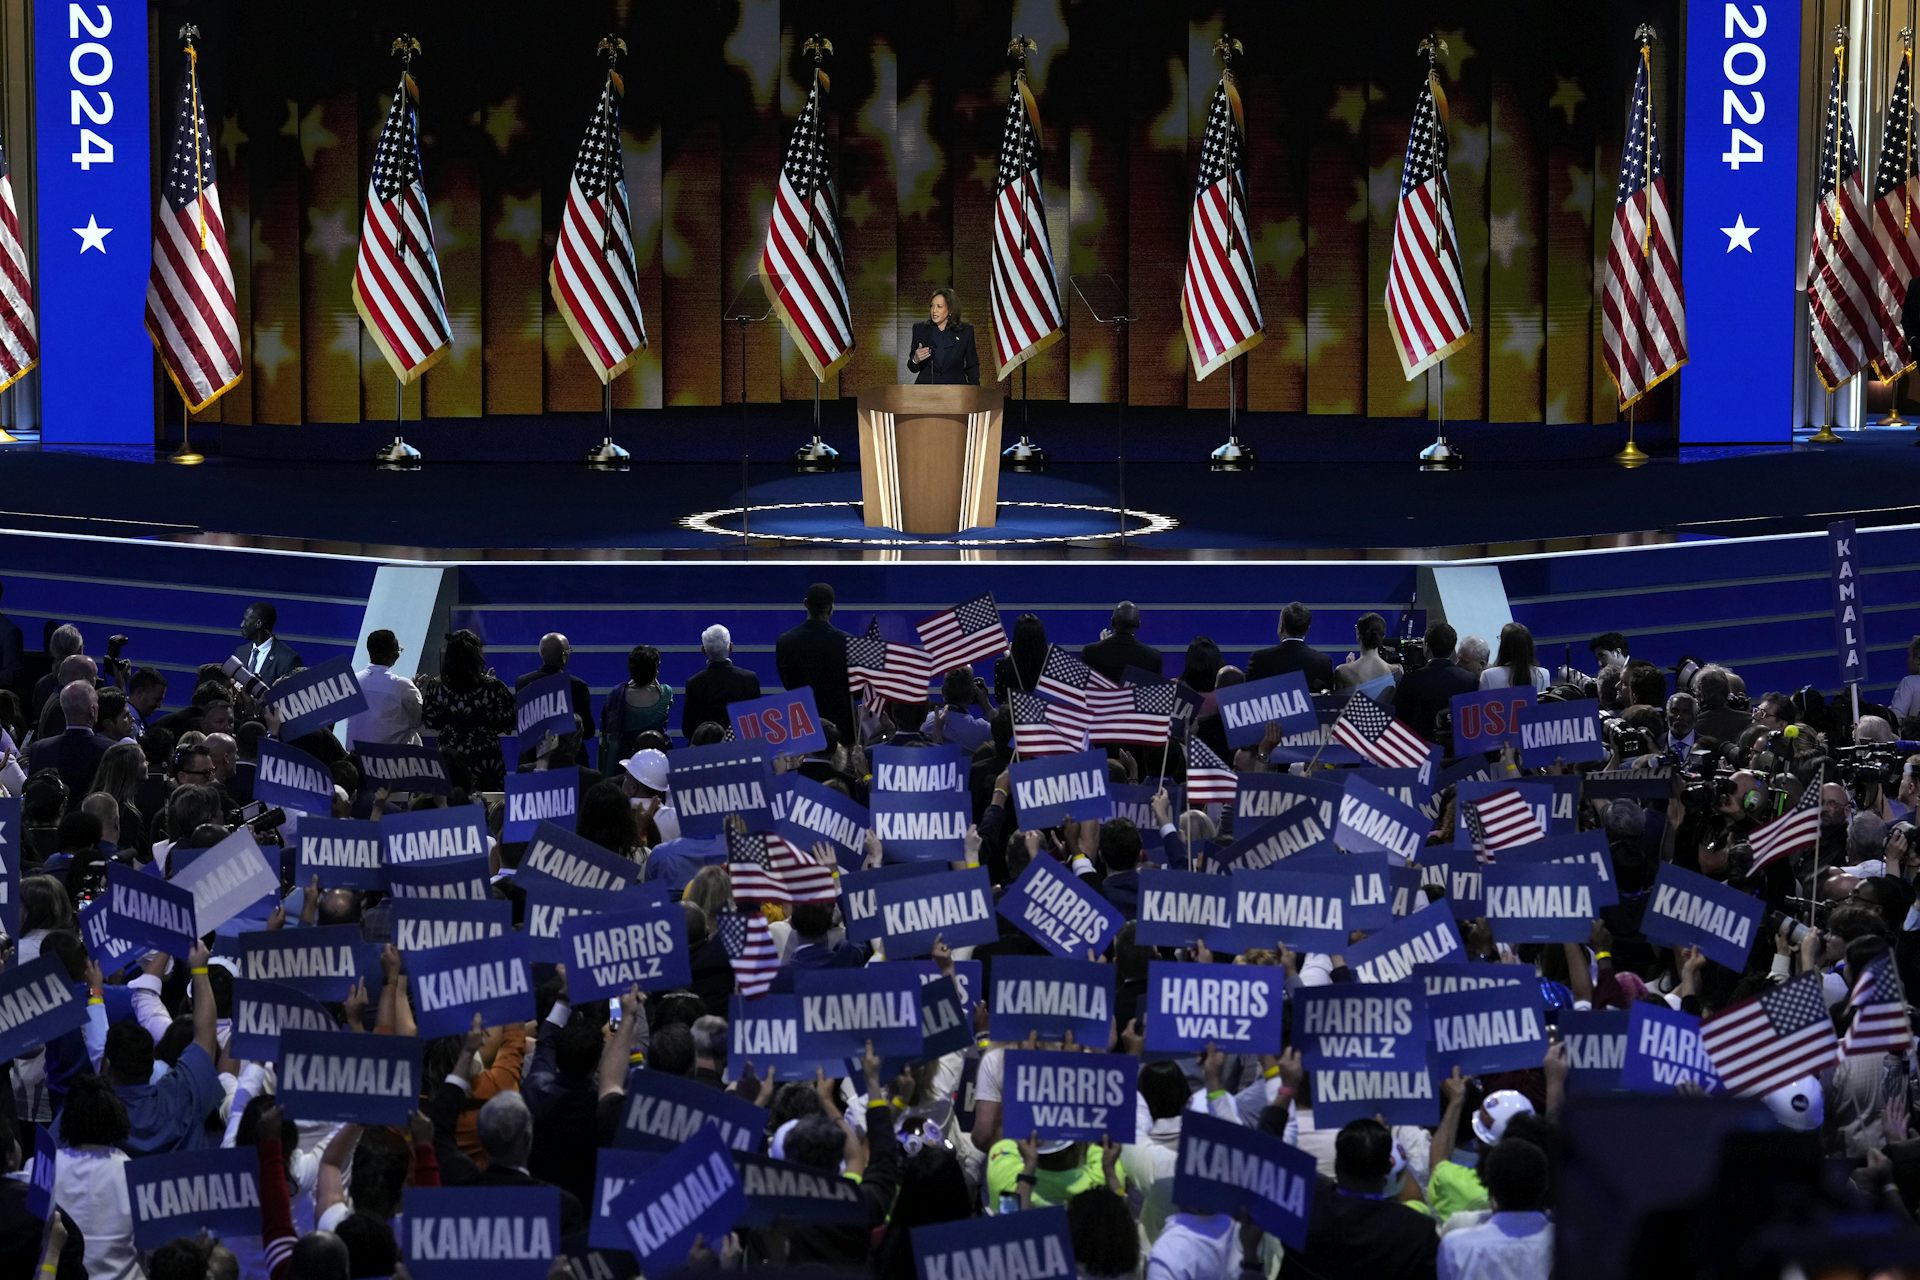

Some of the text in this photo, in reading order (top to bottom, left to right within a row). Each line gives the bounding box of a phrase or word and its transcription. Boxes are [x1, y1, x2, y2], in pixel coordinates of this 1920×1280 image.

[69, 3, 114, 171] 2024
[1722, 3, 1767, 170] 2024
[1836, 538, 1859, 667] KAMALA
[273, 672, 357, 723] KAMALA
[518, 689, 569, 734] KAMALA
[1223, 689, 1310, 729] KAMALA
[738, 702, 816, 745] USA
[1521, 716, 1597, 750] KAMALA
[360, 755, 446, 780] KAMALA
[878, 762, 957, 792] KAMALA
[509, 787, 575, 822] KAMALA
[677, 781, 767, 817] KAMALA
[1016, 769, 1106, 810] KAMALA
[389, 825, 482, 864] KAMALA
[790, 796, 866, 855] KAMALA
[876, 812, 967, 840] KAMALA
[1338, 793, 1420, 862] KAMALA
[302, 836, 387, 869] KAMAL
[112, 884, 195, 938] KAMALA
[883, 889, 991, 936] KAMALA
[1024, 867, 1109, 945] HARRIS
[1142, 890, 1231, 929] KAMAL
[1236, 891, 1343, 930] KAMALA
[1486, 886, 1594, 918] KAMALA
[1653, 883, 1750, 949] KAMALA
[573, 920, 674, 969] HARRIS
[1023, 902, 1082, 953] WALZ
[247, 945, 356, 980] KAMALA
[592, 957, 663, 988] WALZ
[418, 958, 529, 1013] KAMALA
[996, 980, 1107, 1022] KAMALA
[1161, 977, 1269, 1018] HARRIS
[803, 991, 918, 1033] KAMALA
[1176, 1017, 1252, 1041] WALZ
[1304, 998, 1413, 1036] HARRIS
[1434, 1007, 1541, 1053] KAMALA
[1319, 1036, 1396, 1059] WALZ
[283, 1053, 413, 1098] KAMALA
[1016, 1064, 1125, 1107] HARRIS
[1316, 1067, 1433, 1103] KAMALA
[1031, 1105, 1108, 1129] WALZ
[136, 1171, 261, 1222] KAMALA
[1184, 1136, 1306, 1219] KAMALA
[626, 1151, 735, 1258] KAMALA
[411, 1217, 553, 1260] KAMALA
